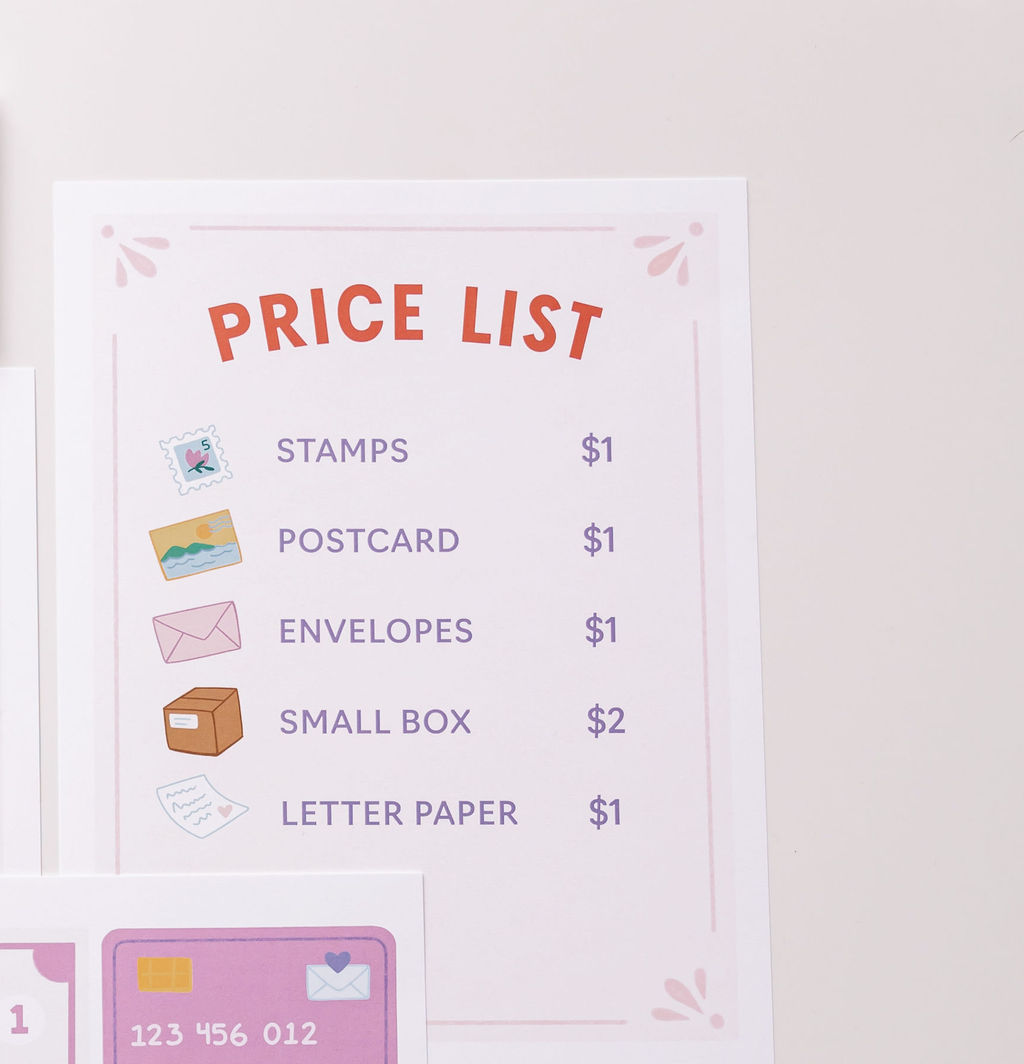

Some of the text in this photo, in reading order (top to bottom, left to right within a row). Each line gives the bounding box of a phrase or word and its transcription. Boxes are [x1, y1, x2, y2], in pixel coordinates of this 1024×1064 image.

[208, 284, 603, 362] PRICE LIST
[201, 439, 211, 451] 5
[278, 432, 613, 467] STAMPS $1
[280, 523, 615, 557] POSTCARD $1
[281, 613, 617, 647] ENVELOPES $1
[281, 704, 626, 738] SMALL BOX $2
[283, 795, 621, 830] LETTER PAPER $1
[10, 1004, 29, 1034] 1
[131, 1021, 318, 1046] 123 456 012
